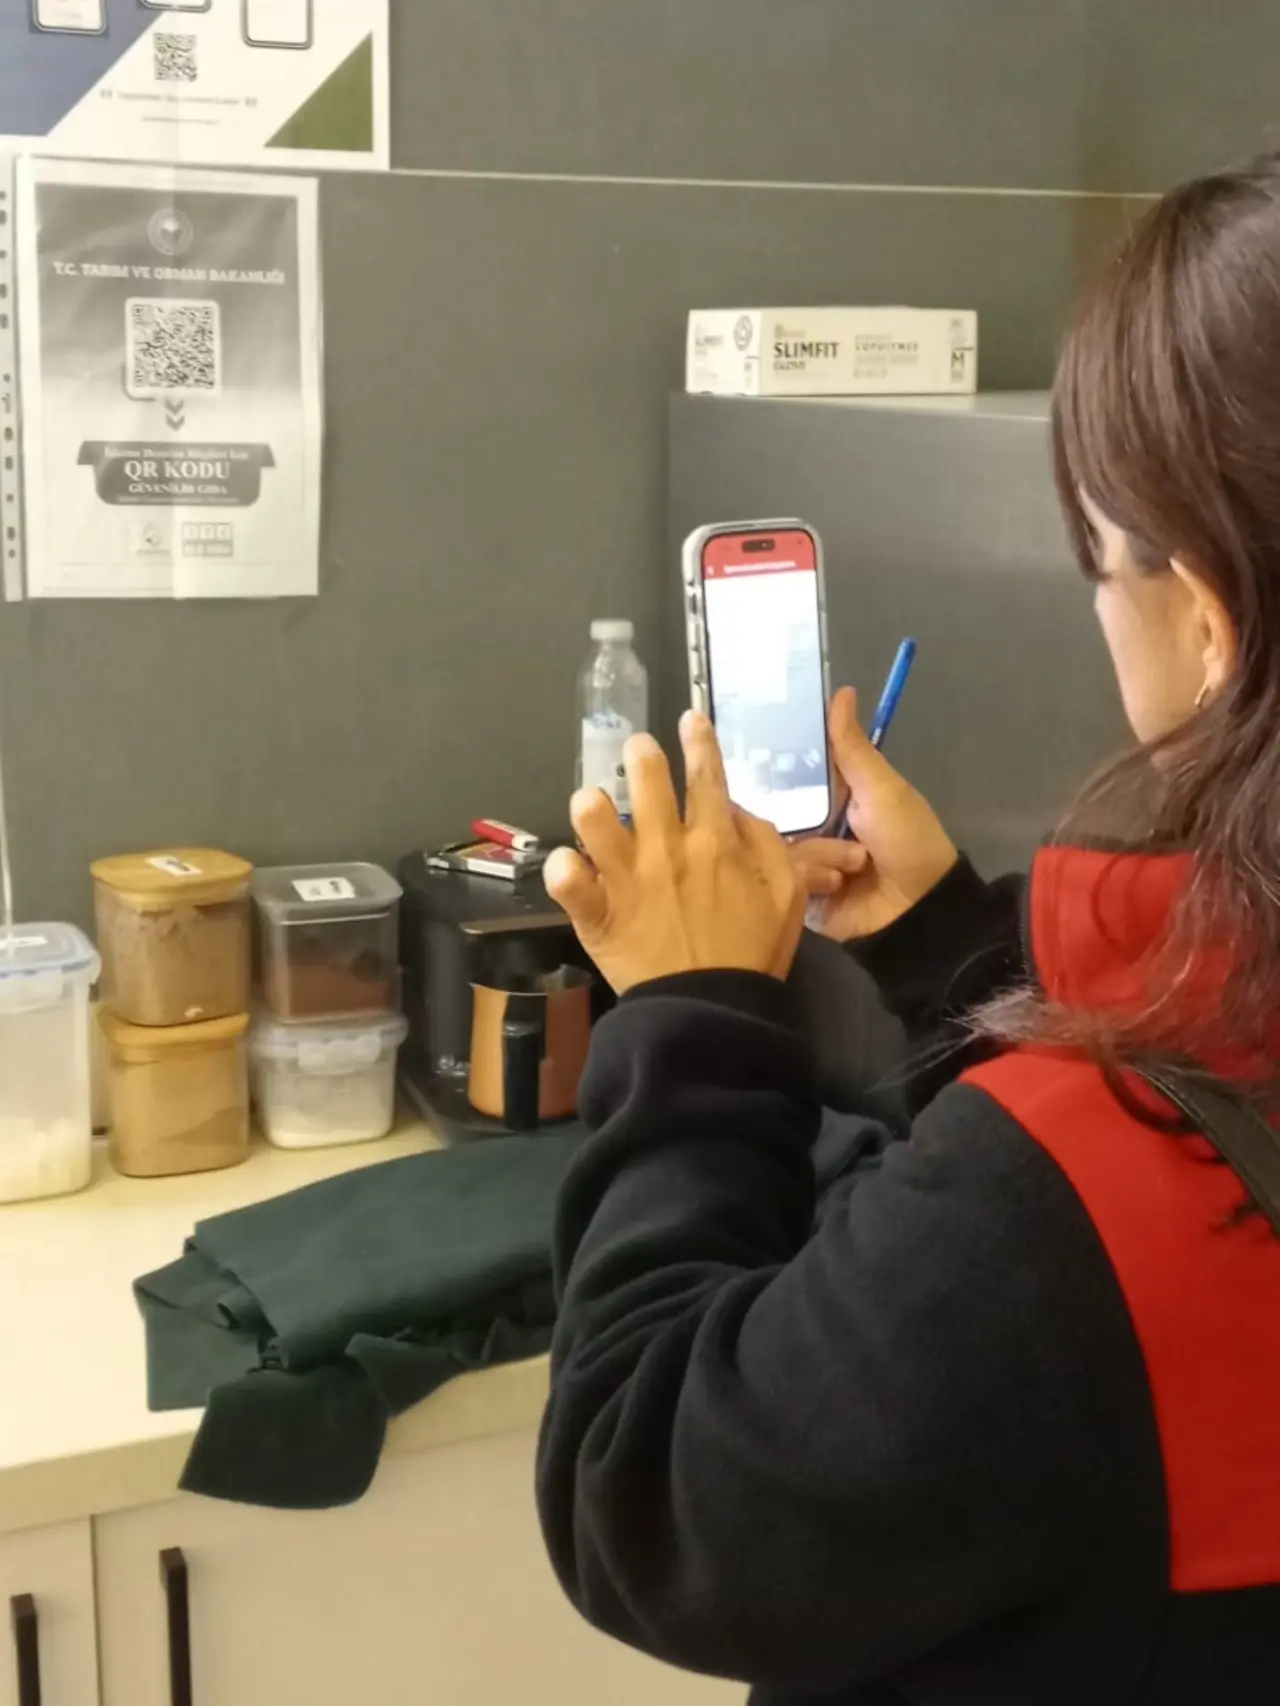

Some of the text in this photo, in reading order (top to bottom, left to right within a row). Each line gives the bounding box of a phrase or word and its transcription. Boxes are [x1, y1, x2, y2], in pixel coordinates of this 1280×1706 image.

[132, 265, 152, 279] VE
[773, 341, 840, 359] SLIMFIT
[124, 460, 230, 481] QR KODU
